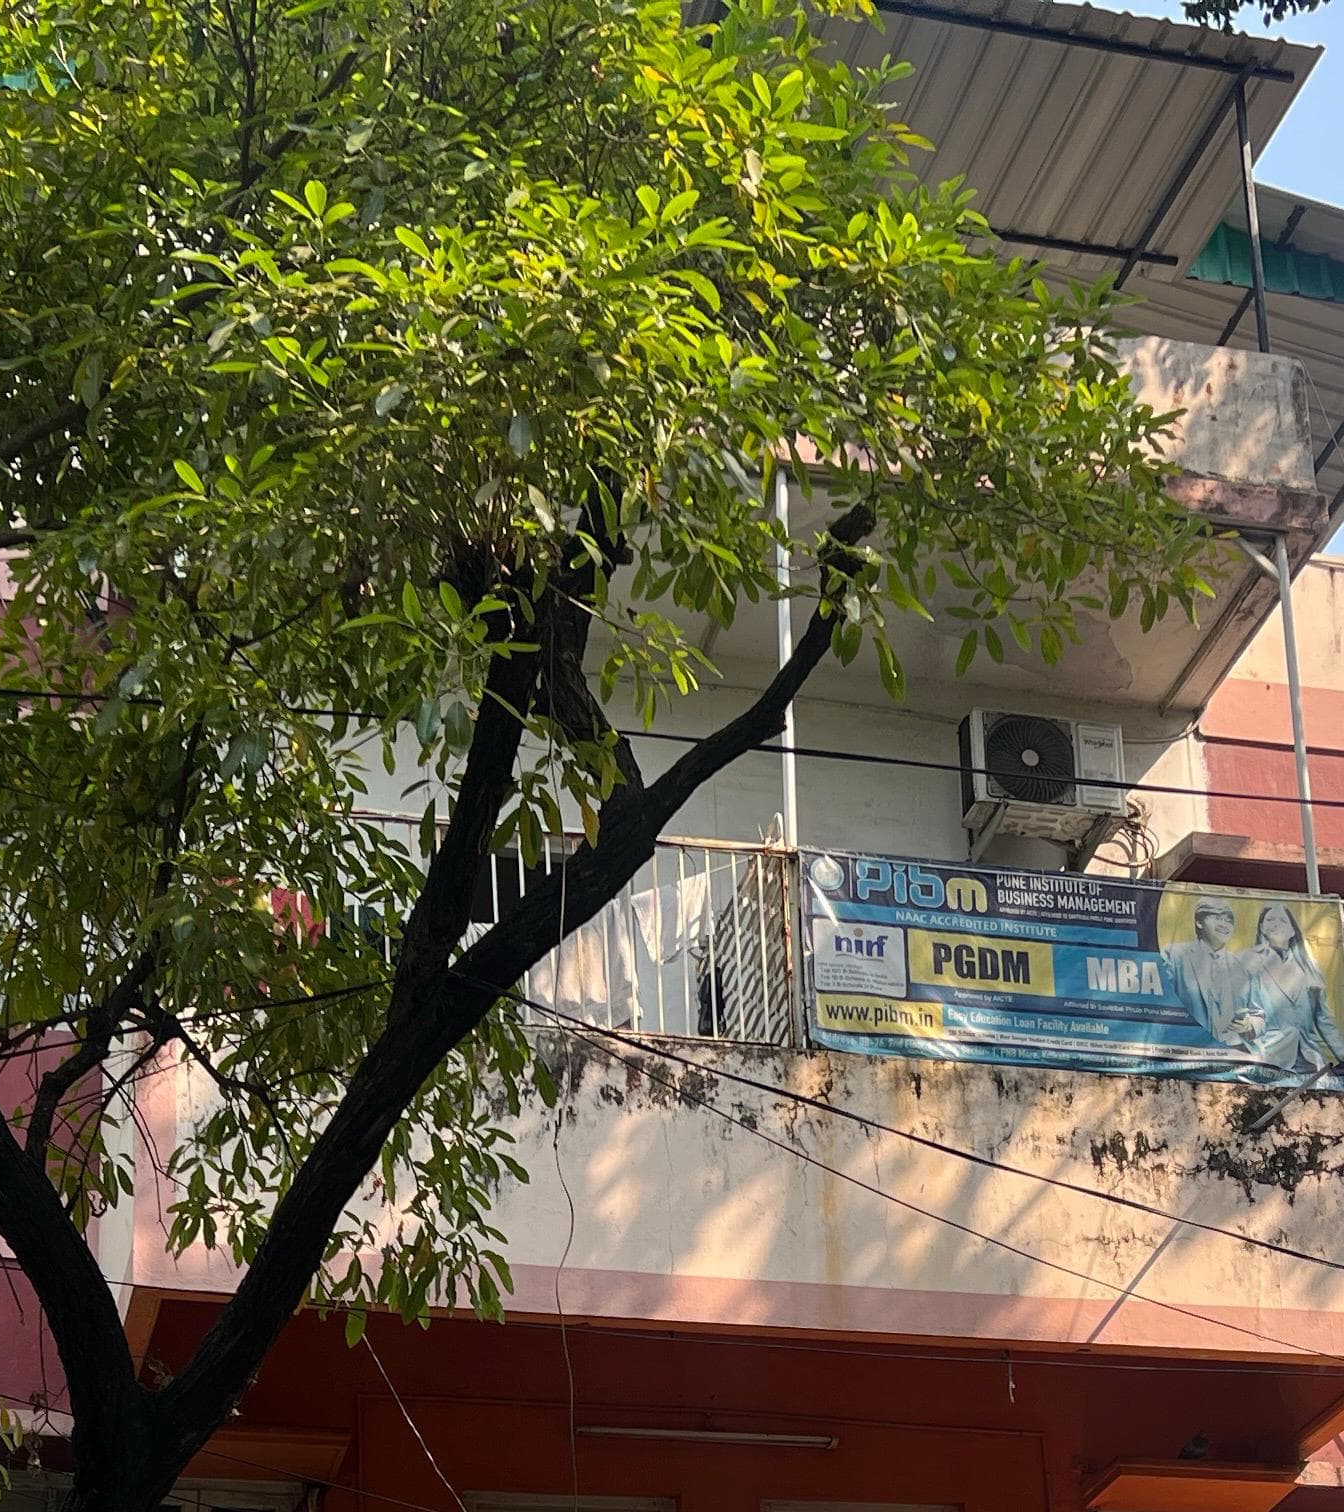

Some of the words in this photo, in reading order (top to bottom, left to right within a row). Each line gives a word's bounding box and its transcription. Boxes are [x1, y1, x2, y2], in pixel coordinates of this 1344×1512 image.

[996, 874, 1026, 890] PUNE
[1030, 877, 1086, 895] INSTITUTE
[1089, 882, 1103, 896] OF
[997, 889, 1054, 908] BUSINESS
[1058, 895, 1137, 915] MANAGEMENT
[896, 911, 927, 924] NAAC
[930, 913, 997, 931] ACCREDITED
[1001, 922, 1057, 937] INSTITUTE
[932, 942, 1031, 985] PGDM
[1087, 956, 1164, 996] MBA
[826, 1003, 933, 1027] www.pibm.in
[970, 1011, 1012, 1027] Education
[1014, 1017, 1036, 1029] Loan
[1037, 1018, 1068, 1034] Facility
[1070, 1021, 1109, 1034] Available
